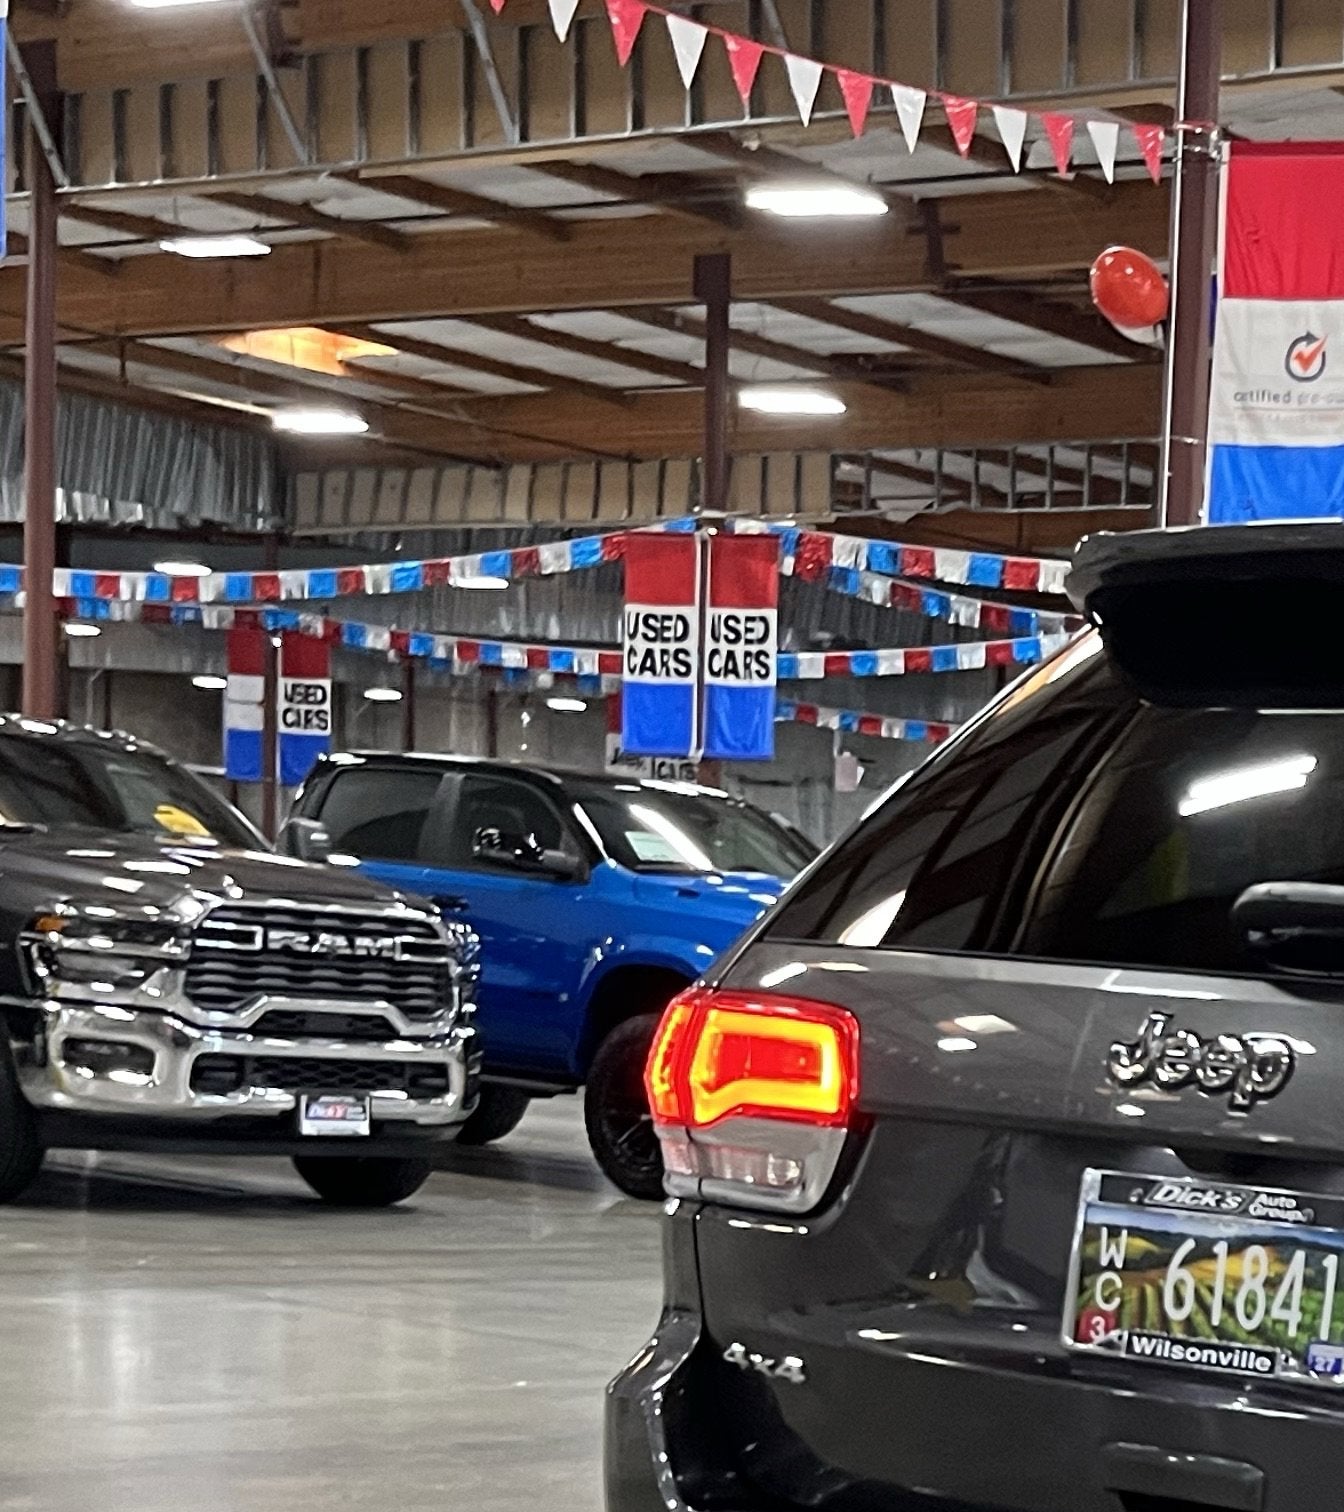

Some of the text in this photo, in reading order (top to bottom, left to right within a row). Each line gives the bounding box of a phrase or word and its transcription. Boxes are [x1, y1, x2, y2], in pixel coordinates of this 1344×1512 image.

[626, 612, 690, 643] USED
[710, 614, 770, 645] USED
[626, 646, 692, 678] CARS
[708, 648, 770, 680] CARS
[267, 929, 395, 958] RAM
[1107, 1011, 1296, 1112] Jeep
[1152, 1184, 1243, 1210] Dick's
[1255, 1193, 1297, 1209] Auto
[1163, 1237, 1339, 1342] 61841
[722, 1342, 806, 1384] 4x4
[1131, 1335, 1273, 1373] Wilsonville
